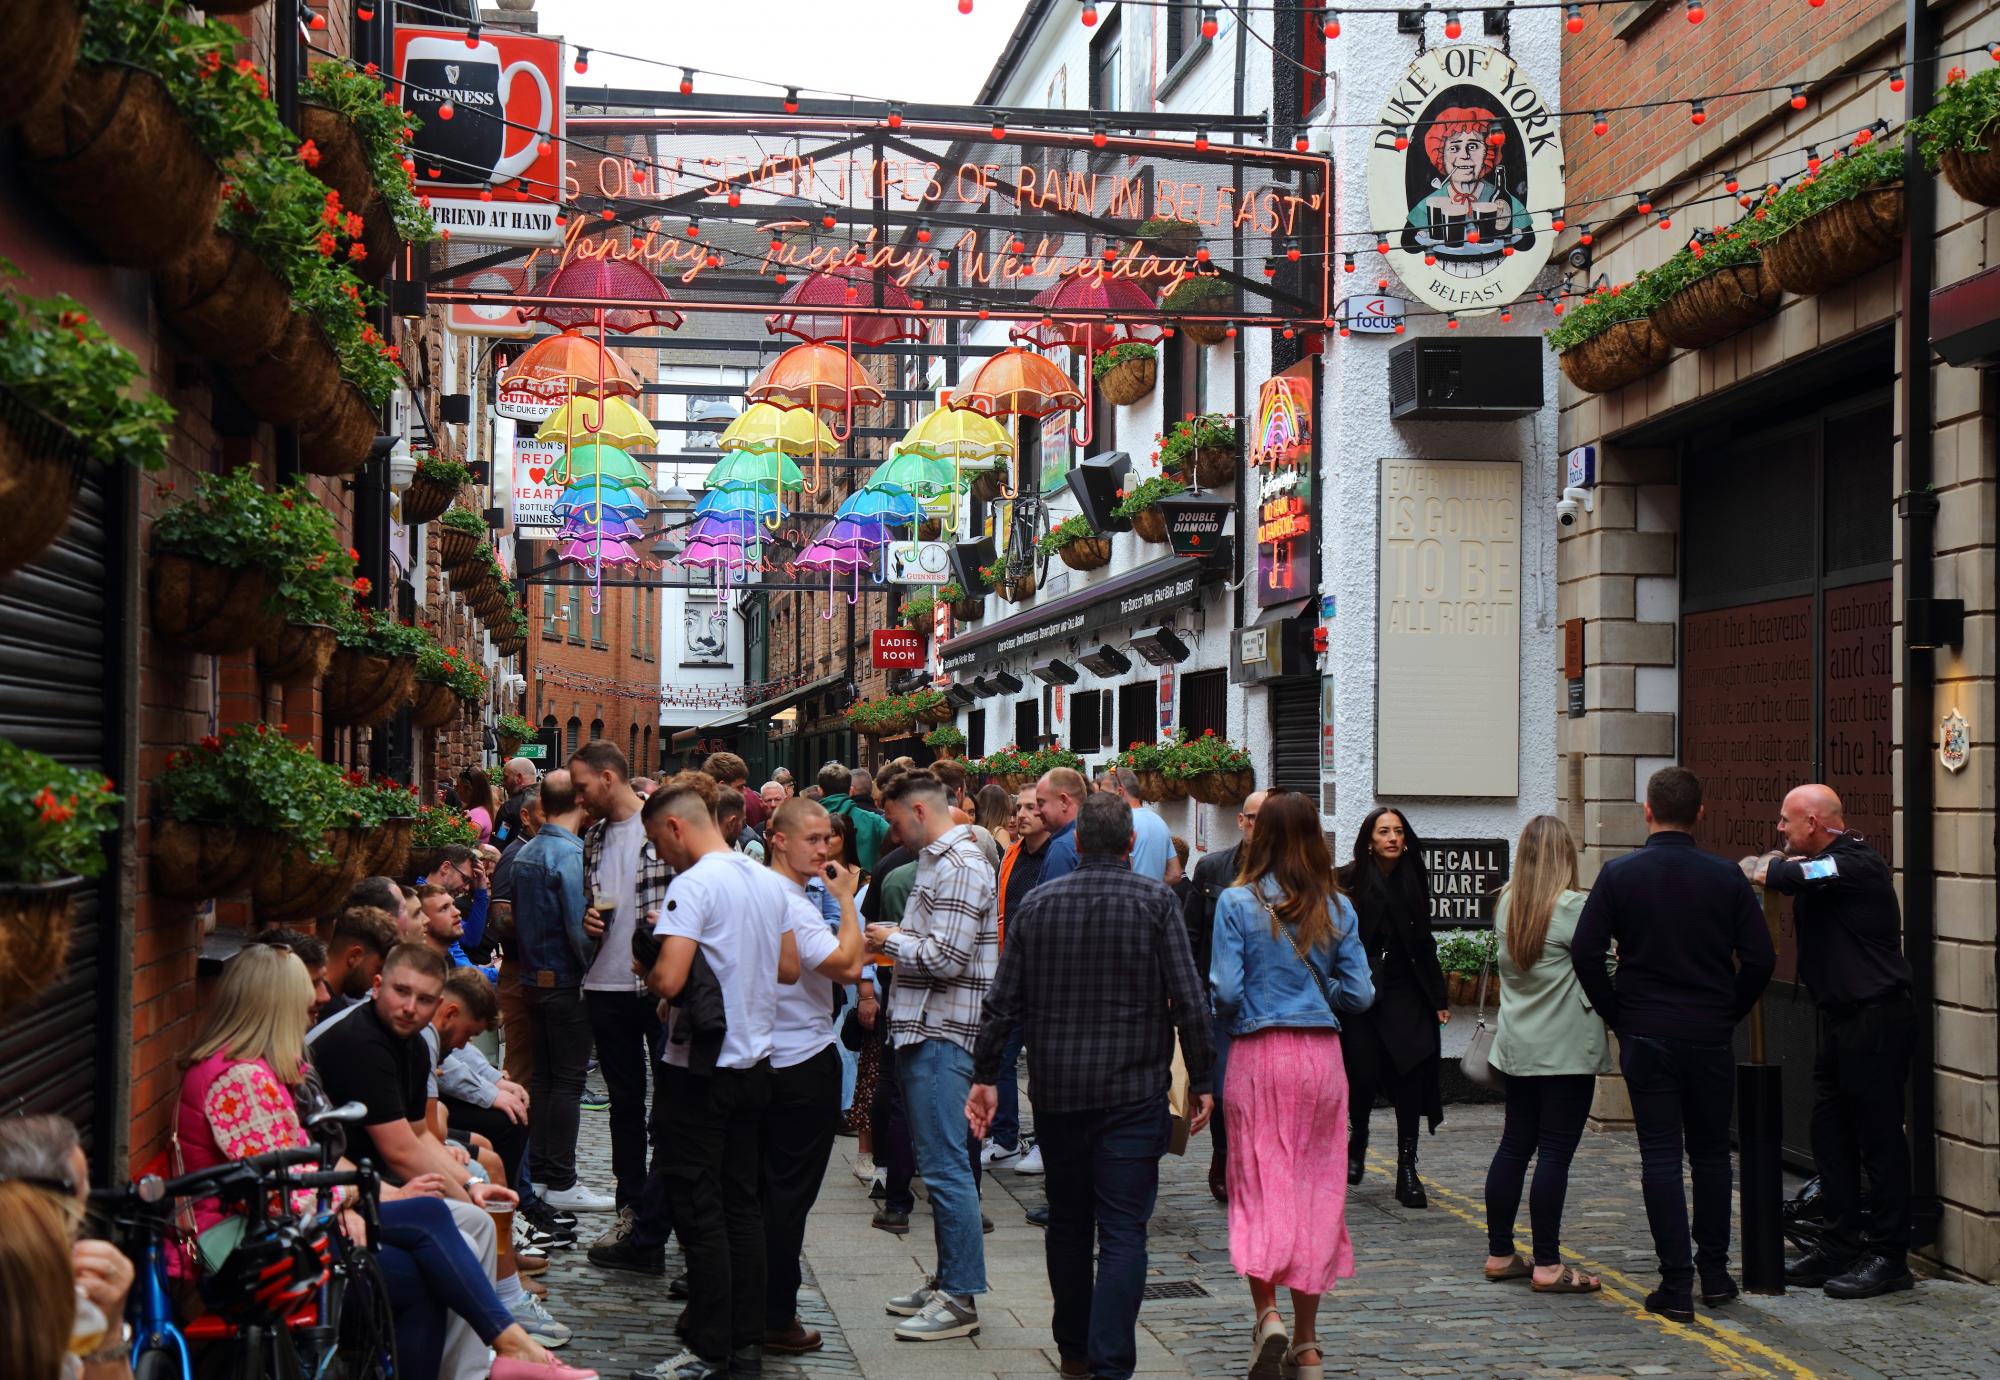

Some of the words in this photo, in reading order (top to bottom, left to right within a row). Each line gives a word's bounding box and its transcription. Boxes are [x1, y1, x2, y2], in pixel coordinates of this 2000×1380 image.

[413, 88, 495, 105] GUINNESS
[1373, 66, 1437, 154] DUKE
[1444, 48, 1487, 78] OF
[1498, 66, 1558, 156] YORK
[598, 154, 684, 198] ONLY
[703, 154, 814, 198] SEVEN
[833, 159, 942, 202] TYPES
[958, 163, 1000, 204] OF
[1015, 165, 1096, 214] RAIN
[1108, 174, 1142, 218] IN
[432, 207, 486, 227] FRIEND
[491, 210, 508, 228] AT
[512, 212, 552, 232] HAND
[1428, 279, 1504, 304] BELFAST
[1356, 311, 1397, 330] focus
[500, 403, 514, 413] THE
[517, 405, 537, 415] DUKE
[538, 407, 548, 415] OF
[522, 453, 554, 465] RED
[1388, 466, 1516, 496] EVERYTHING
[512, 488, 564, 499] HEART
[514, 513, 562, 524] GUINNESS
[1173, 521, 1219, 533] DIAMOND
[1177, 512, 1216, 524] DOUBLE
[1387, 496, 1416, 537] IS
[1422, 497, 1516, 538] GOING
[906, 572, 946, 582] GUINNESS
[1387, 538, 1445, 600] TO
[1458, 539, 1515, 600] BE
[1388, 600, 1433, 634] ALL
[1438, 601, 1514, 636] RIGHT
[1724, 615, 1745, 647] the
[880, 638, 918, 648] LADIES
[882, 649, 916, 661] ROOM
[1830, 635, 1865, 680] and
[1736, 695, 1759, 723] and
[1761, 694, 1782, 722] the
[1830, 688, 1858, 722] and
[1861, 687, 1888, 722] the
[1731, 734, 1753, 762] and
[1786, 731, 1811, 762] and
[1829, 731, 1865, 776] the
[1427, 874, 1486, 894] UARE
[1429, 898, 1479, 918] ORTH
